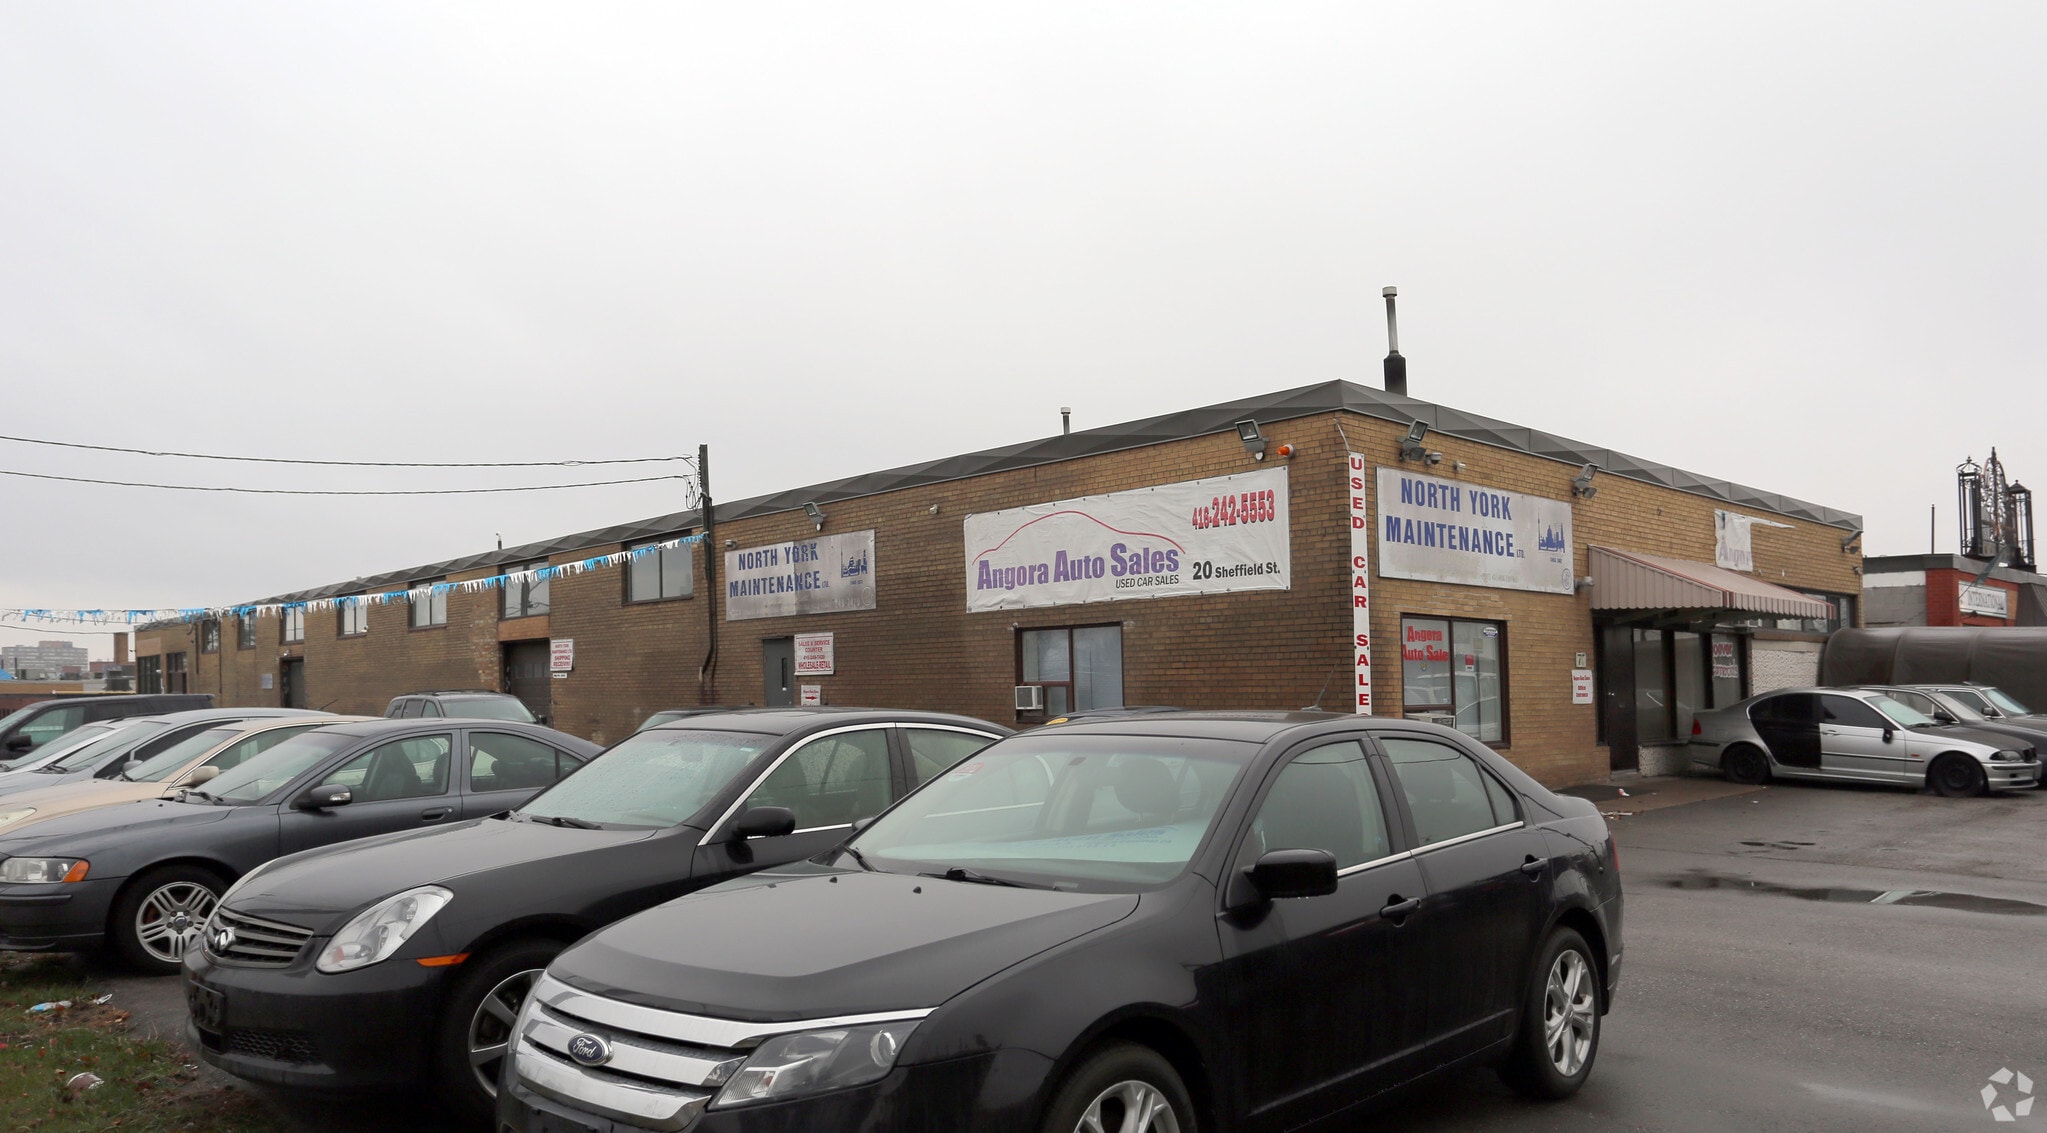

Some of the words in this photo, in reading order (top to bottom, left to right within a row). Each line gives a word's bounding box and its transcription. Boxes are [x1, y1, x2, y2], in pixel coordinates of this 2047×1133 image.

[1191, 489, 1275, 530] 416-242-5553
[1350, 457, 1365, 529] USED
[1401, 477, 1461, 513] NORTH
[1469, 489, 1512, 521] YORK
[1385, 515, 1515, 558] MAINTENANCE
[738, 548, 778, 571] NORTH
[784, 542, 819, 565] YORK
[977, 559, 1049, 591] Angora
[1053, 550, 1105, 583] Auto
[1110, 542, 1180, 577] Sales
[1192, 560, 1213, 580] 20
[1215, 563, 1264, 578] Sheffield
[1265, 561, 1281, 574] St.
[729, 571, 820, 598] MAINTENANCE
[1115, 577, 1136, 589] USED
[1136, 575, 1153, 587] CAR
[1154, 574, 1180, 586] SALES
[1353, 556, 1368, 609] CAR
[1406, 625, 1443, 643] Angora
[1402, 643, 1424, 661] Auto
[1356, 634, 1370, 715] SALE
[572, 1037, 598, 1058] Ford
